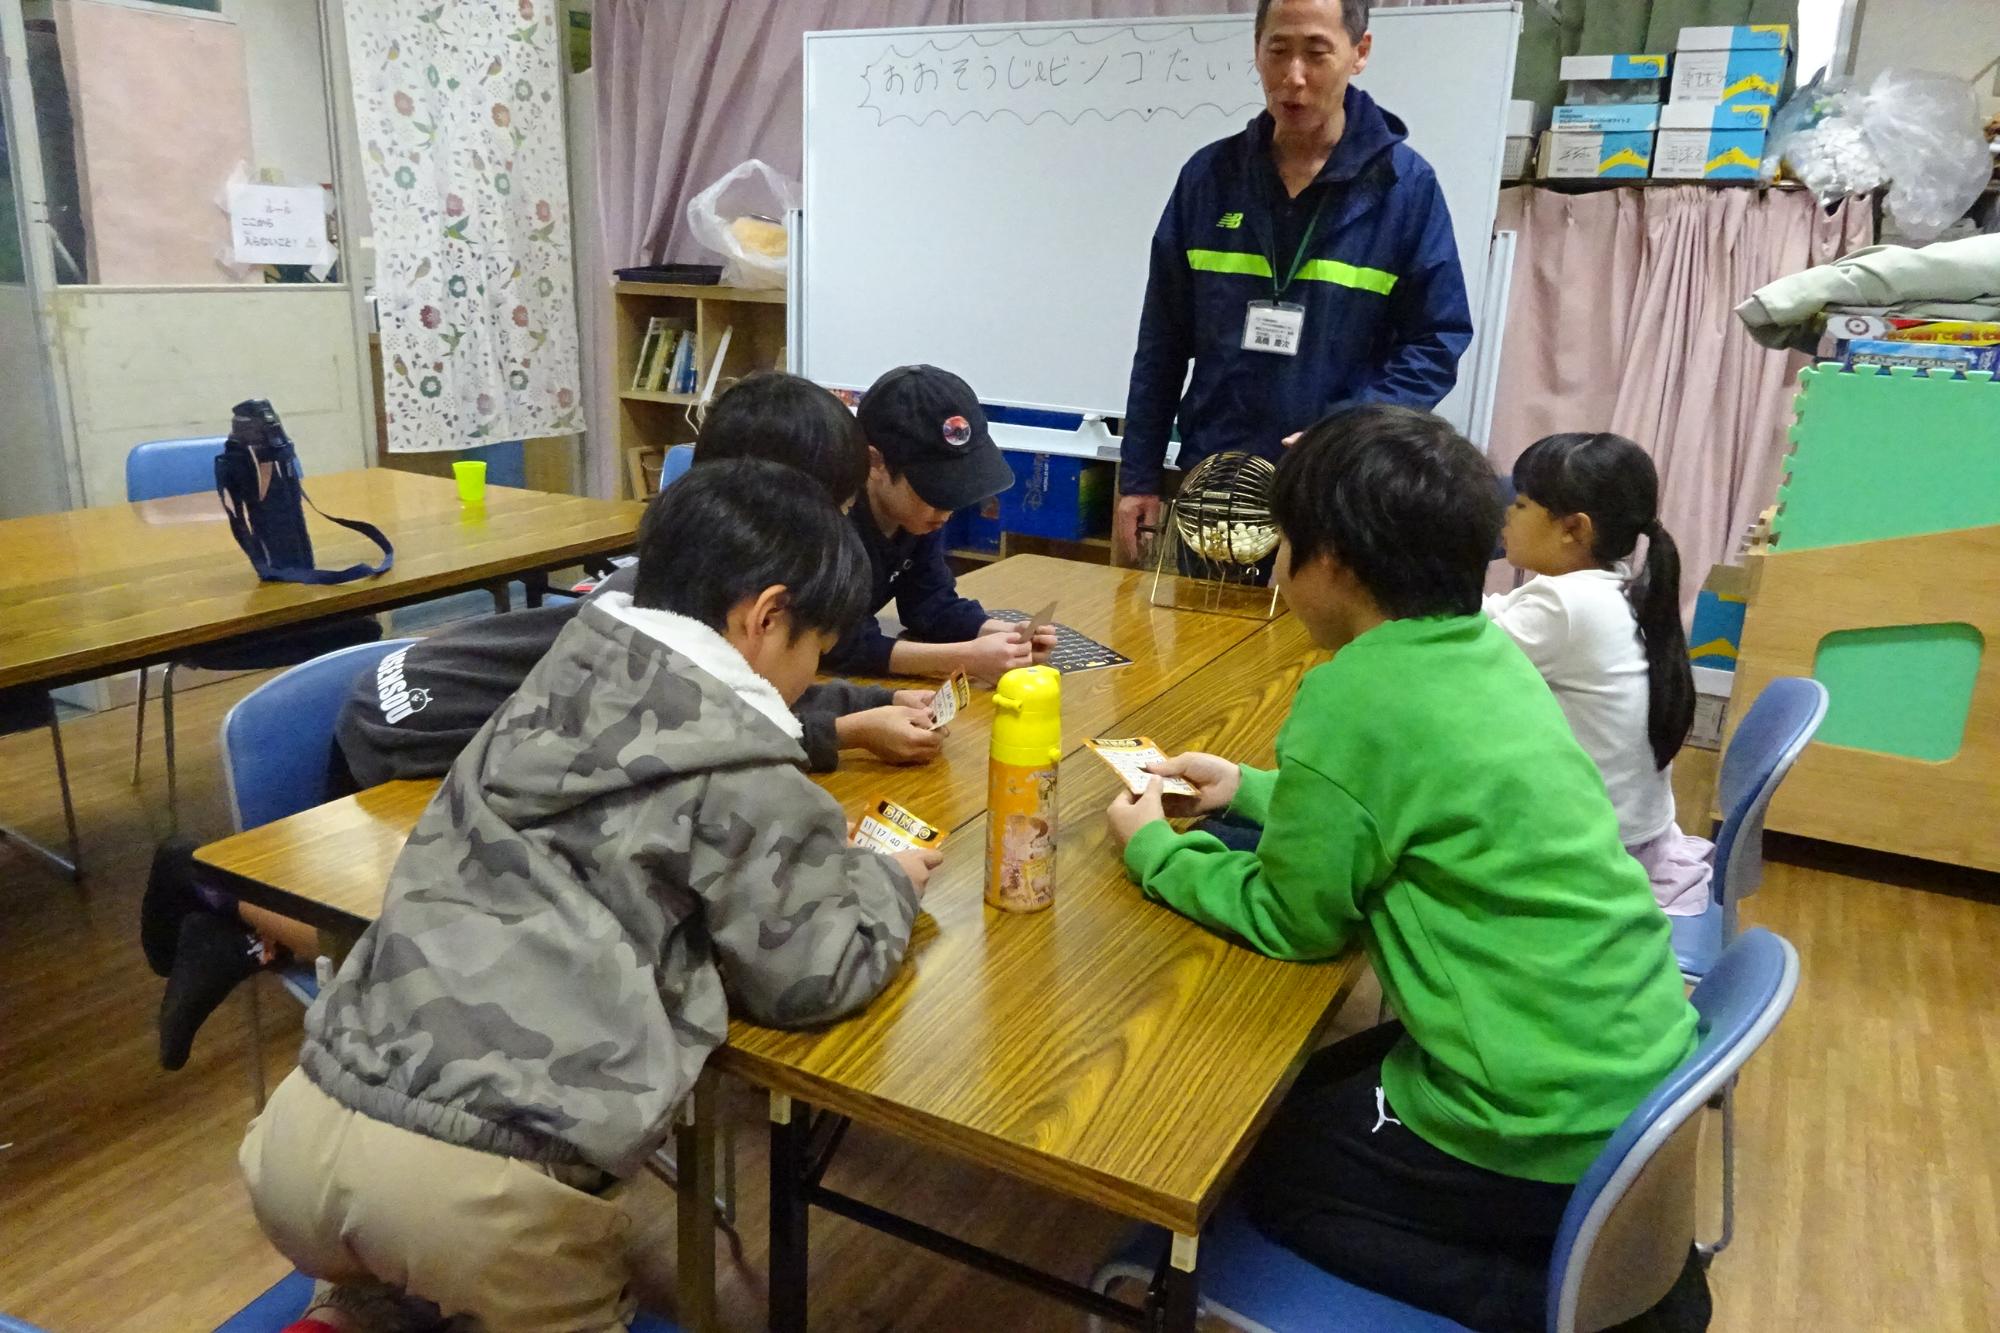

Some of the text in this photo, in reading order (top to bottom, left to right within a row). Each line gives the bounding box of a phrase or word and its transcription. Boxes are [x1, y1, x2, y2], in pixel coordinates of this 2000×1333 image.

[882, 804, 931, 839] BINGO
[876, 829, 886, 838] 17
[890, 837, 901, 847] 40
